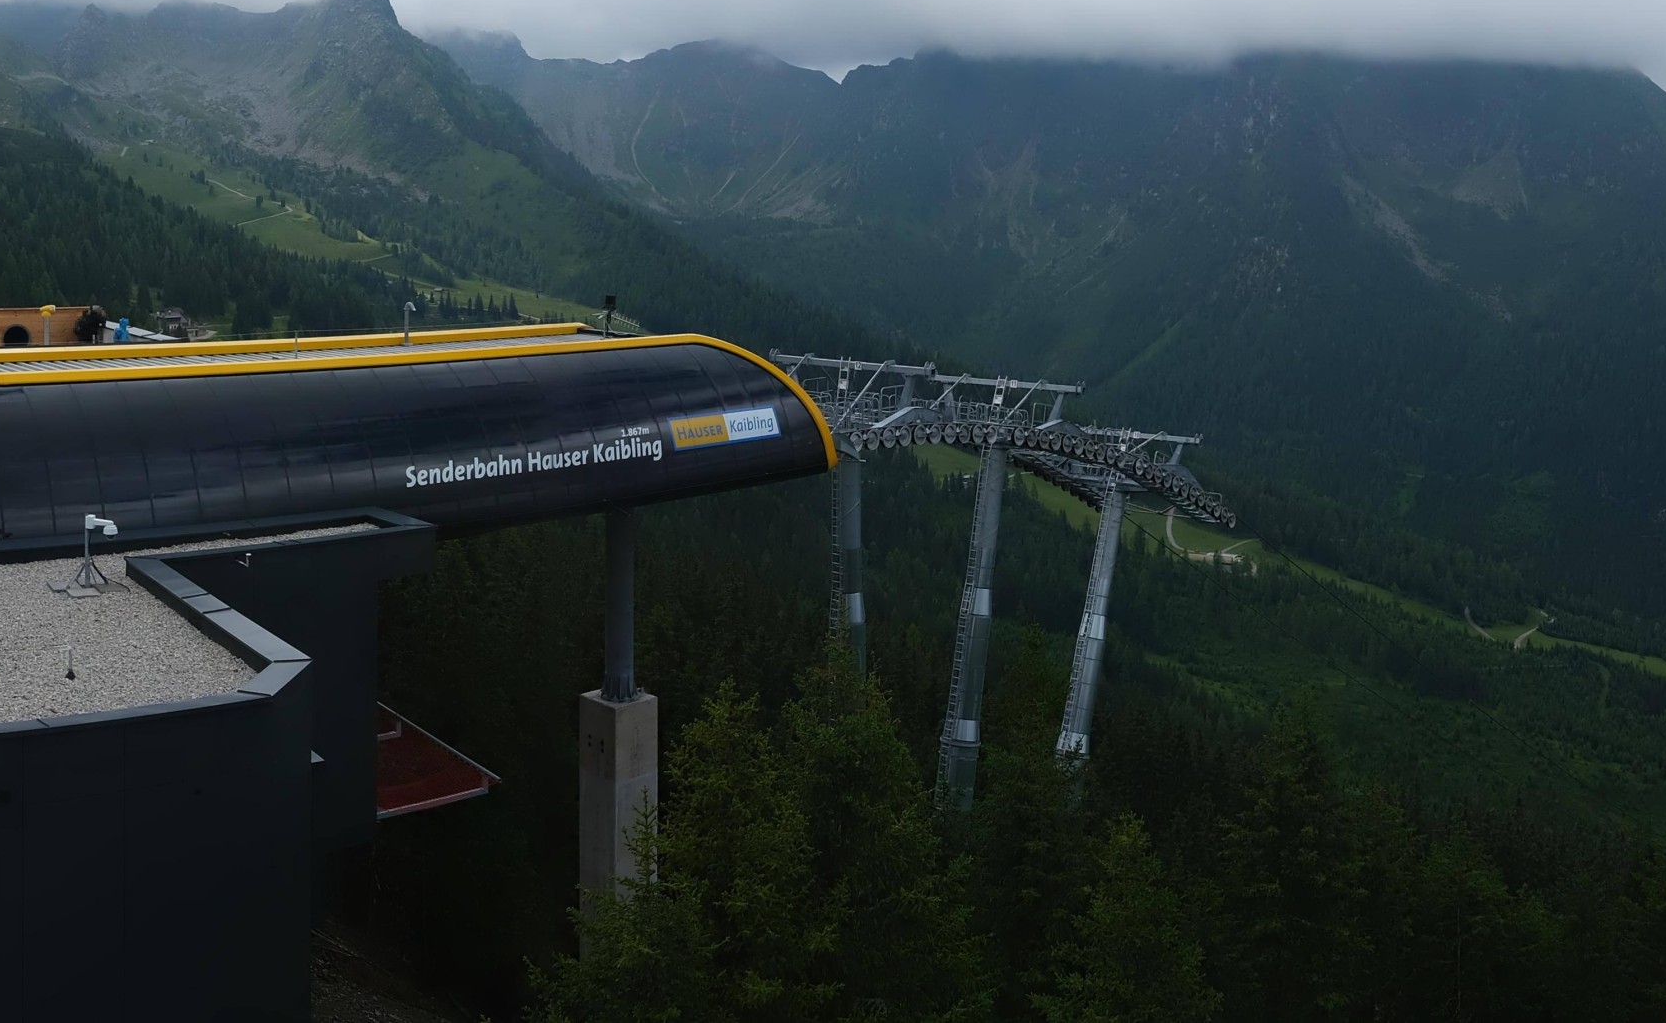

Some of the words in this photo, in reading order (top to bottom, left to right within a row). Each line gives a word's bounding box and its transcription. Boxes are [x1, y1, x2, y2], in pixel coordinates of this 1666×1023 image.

[620, 426, 650, 438] 1.867m
[676, 423, 723, 441] HAUSER
[729, 415, 775, 435] Kaibling
[405, 453, 523, 488] Senderbahn
[527, 449, 589, 473] Hauser
[592, 435, 663, 462] Kaibling
